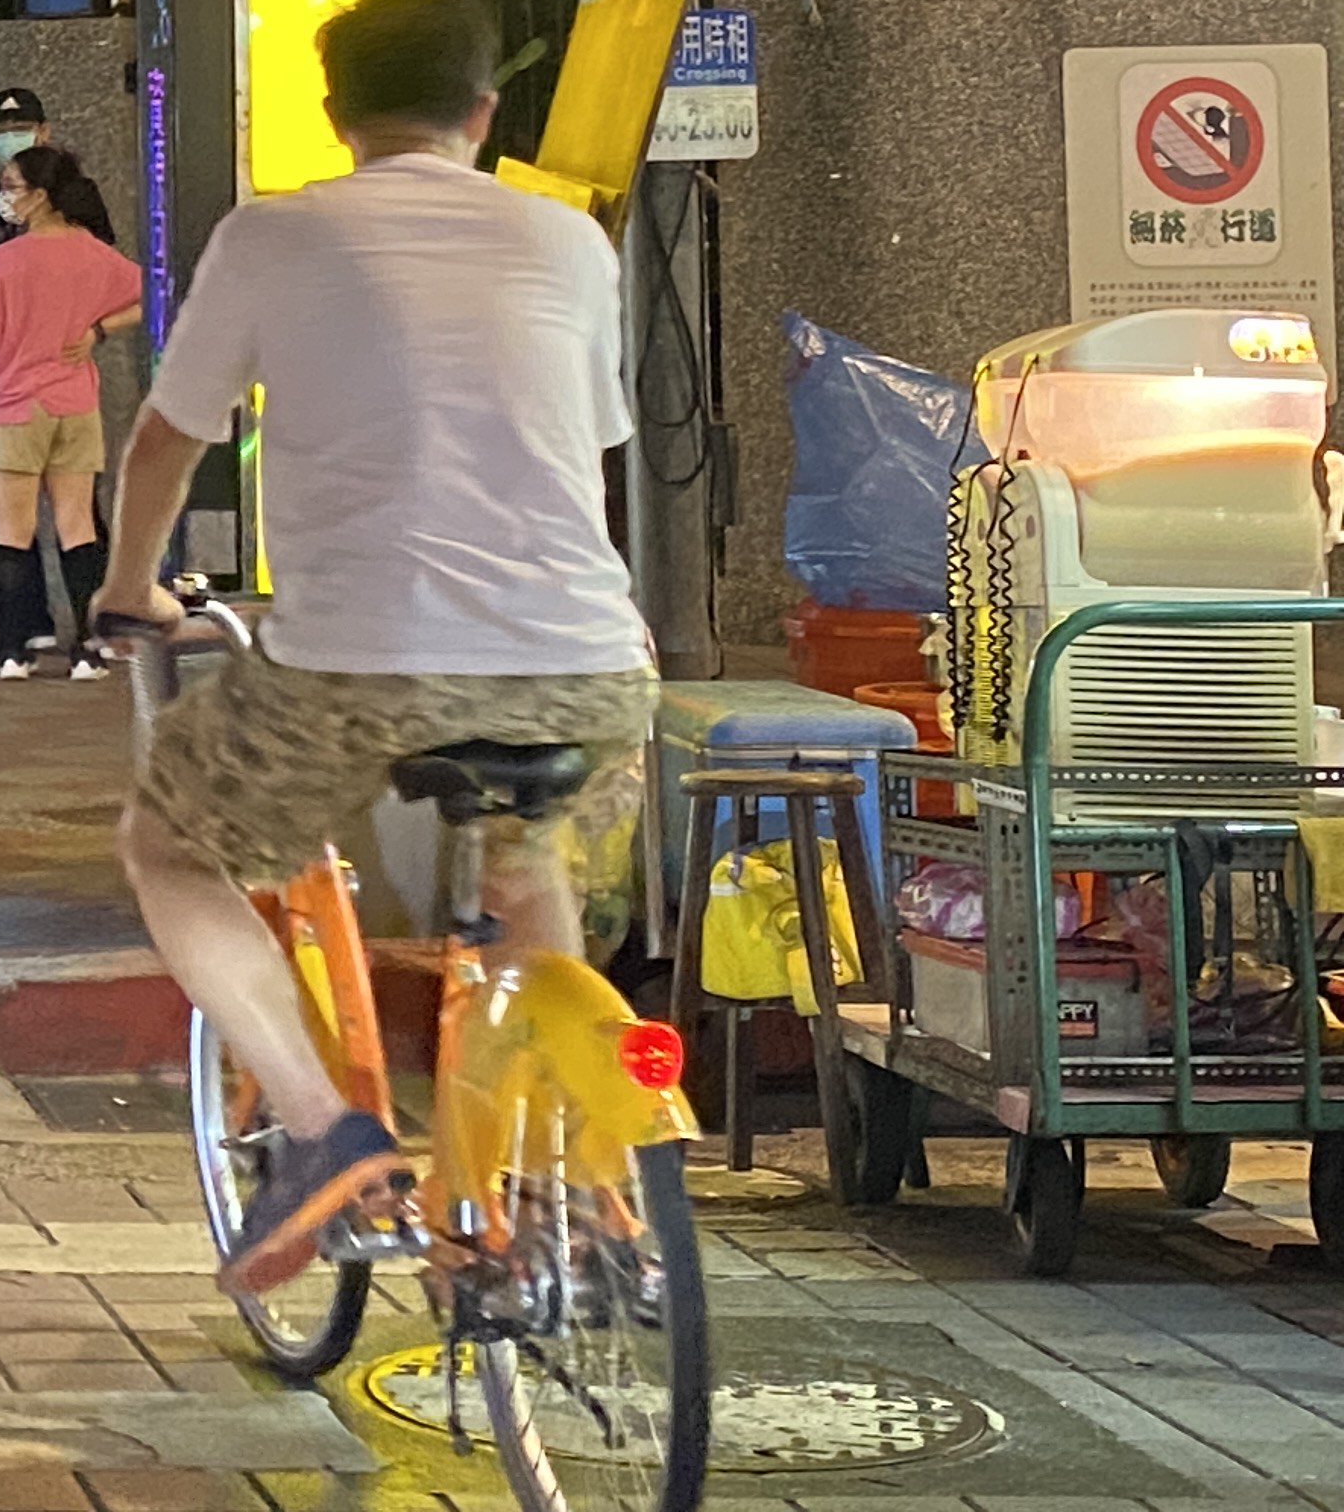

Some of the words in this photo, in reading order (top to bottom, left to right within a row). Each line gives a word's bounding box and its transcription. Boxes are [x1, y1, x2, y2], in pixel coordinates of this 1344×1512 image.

[674, 14, 750, 66] 用時相
[673, 66, 748, 83] Crossing
